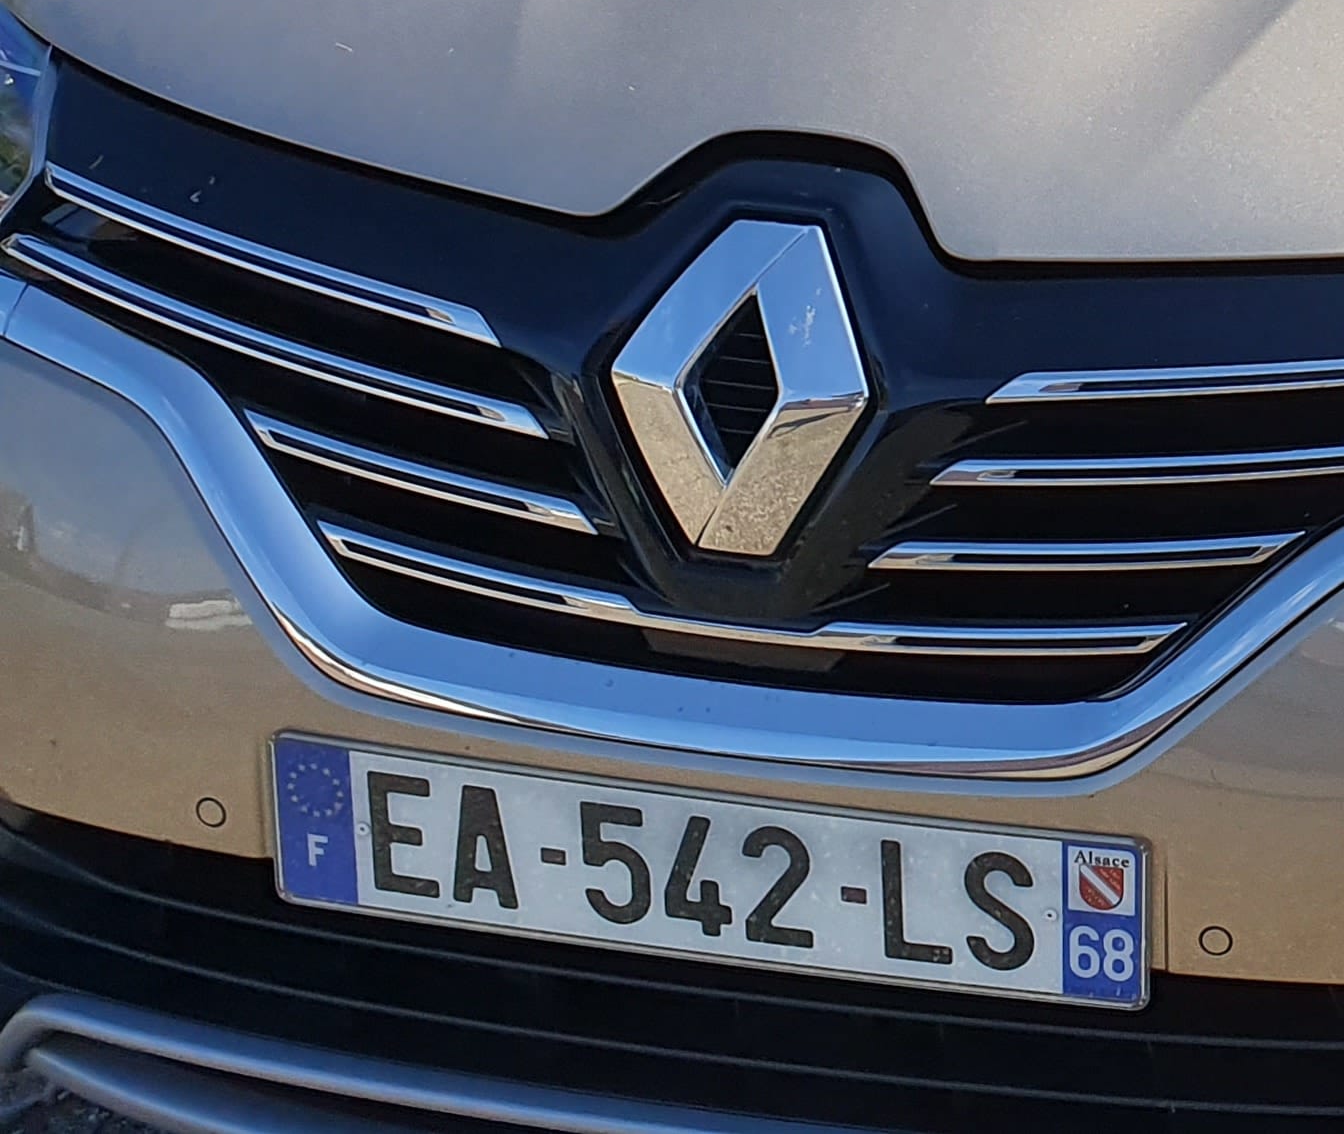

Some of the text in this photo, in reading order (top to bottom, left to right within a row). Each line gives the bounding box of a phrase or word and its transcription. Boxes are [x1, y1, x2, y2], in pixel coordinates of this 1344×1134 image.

[306, 833, 329, 867] F
[366, 770, 1036, 972] EA-542-LS
[1074, 850, 1130, 868] Alsace
[1069, 925, 1135, 982] 68
